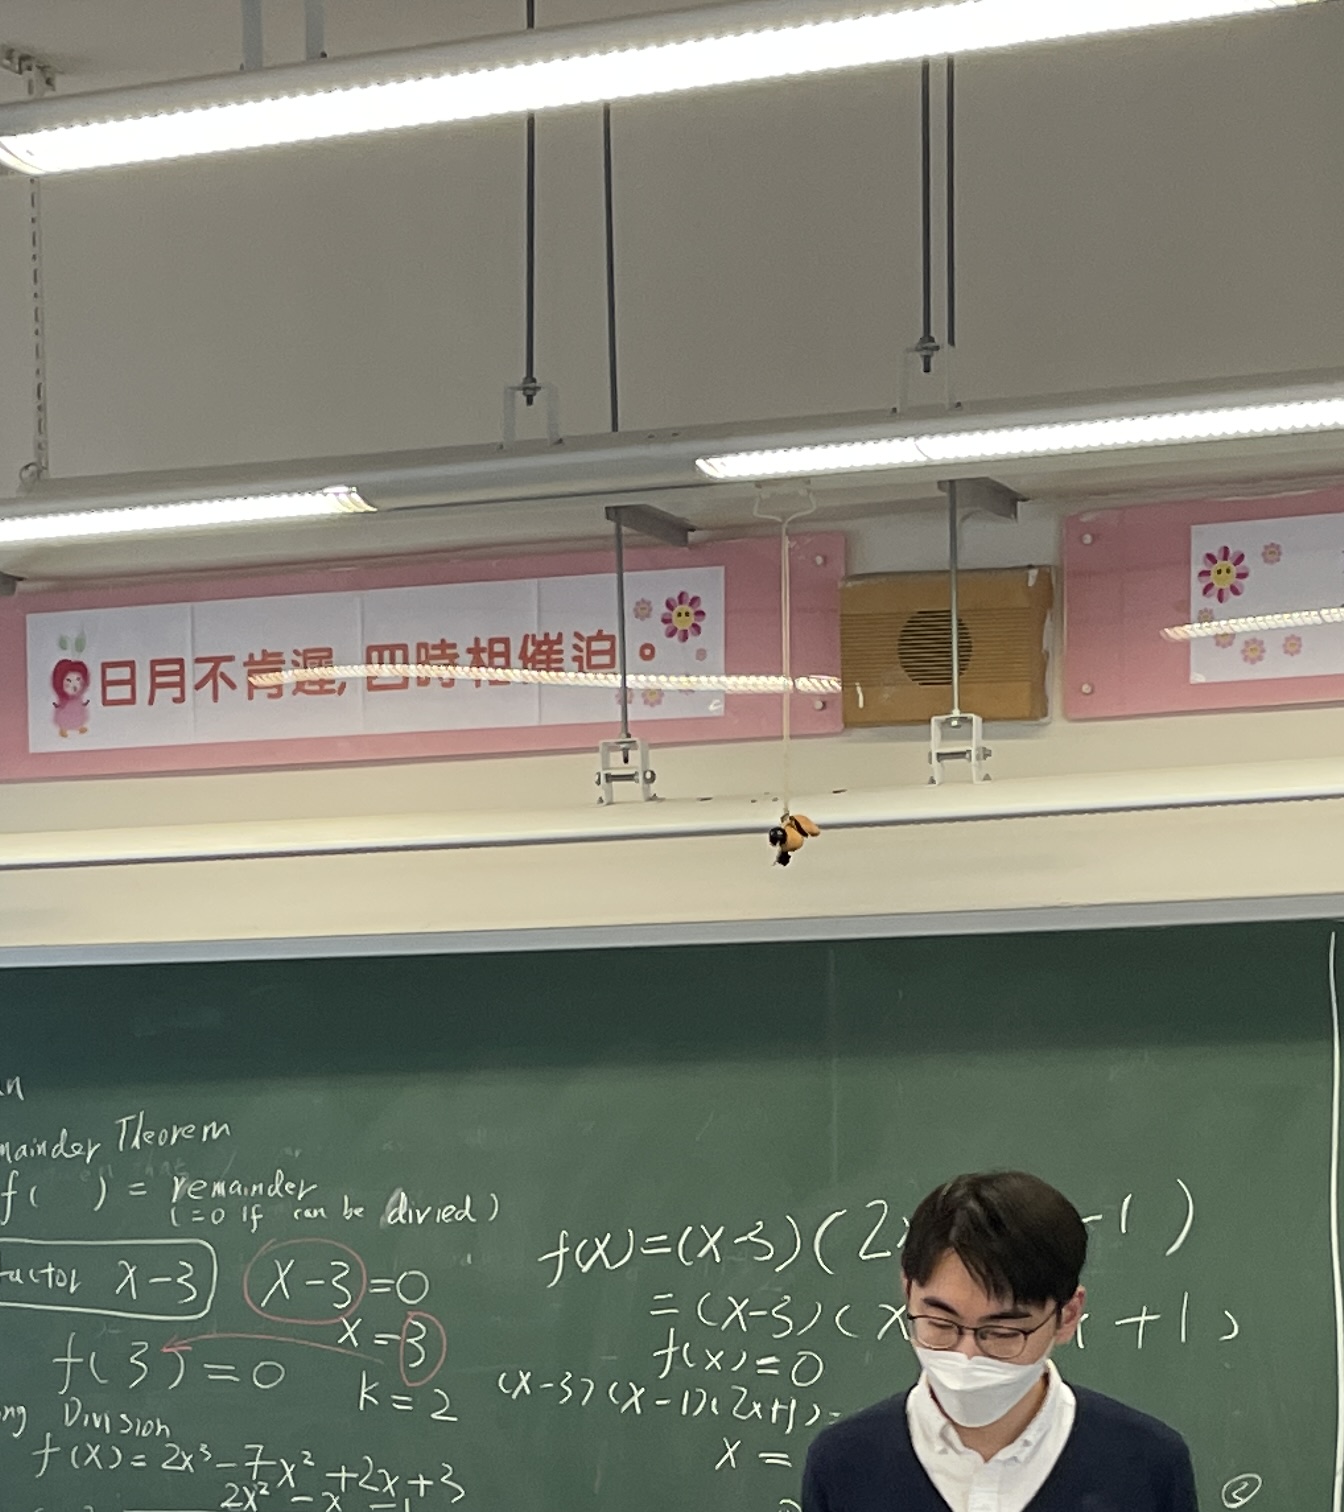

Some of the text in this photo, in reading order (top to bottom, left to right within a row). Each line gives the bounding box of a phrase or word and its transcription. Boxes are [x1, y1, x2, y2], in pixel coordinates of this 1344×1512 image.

[115, 1110, 231, 1152] Theorem
[170, 1168, 318, 1204] remainder
[293, 1206, 328, 1220] can
[342, 1193, 365, 1220] be
[64, 1396, 171, 1438] Division
